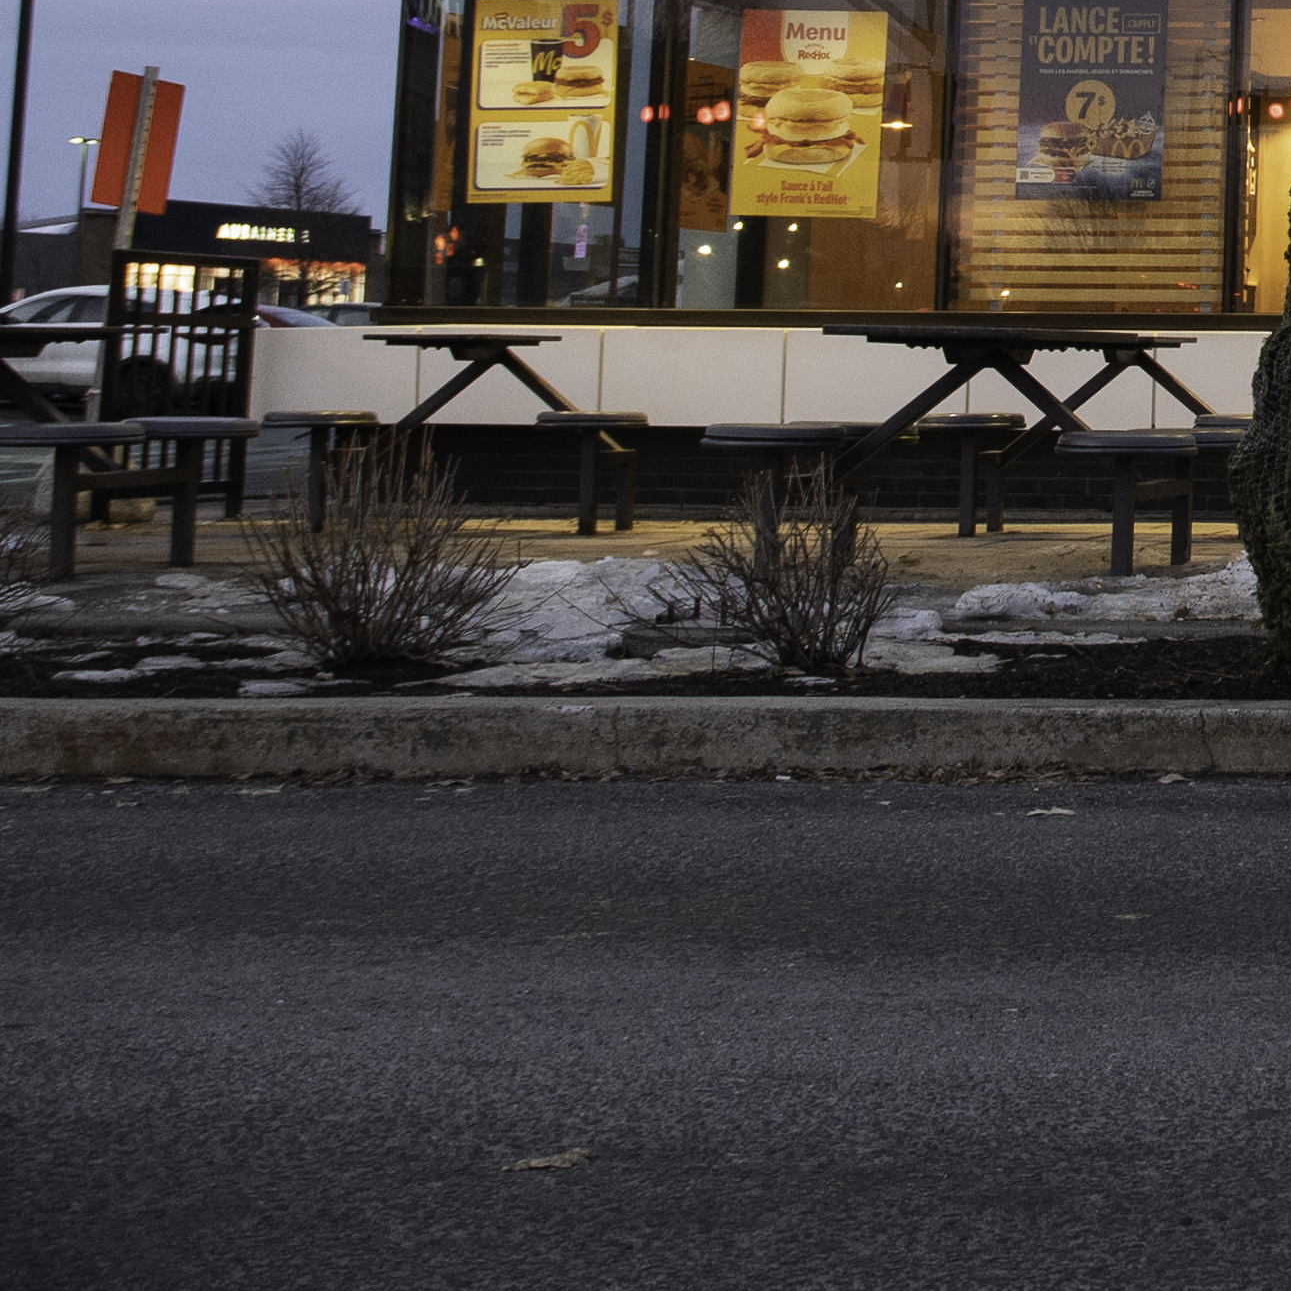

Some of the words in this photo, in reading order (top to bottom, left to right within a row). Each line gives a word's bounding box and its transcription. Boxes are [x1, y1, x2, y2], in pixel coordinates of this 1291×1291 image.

[482, 15, 559, 30] McValeur
[1039, 6, 1120, 35] LANCE
[785, 22, 846, 41] Menu
[781, 180, 809, 191] Sauce
[756, 193, 779, 206] style
[216, 222, 310, 243] AUBAINERE
